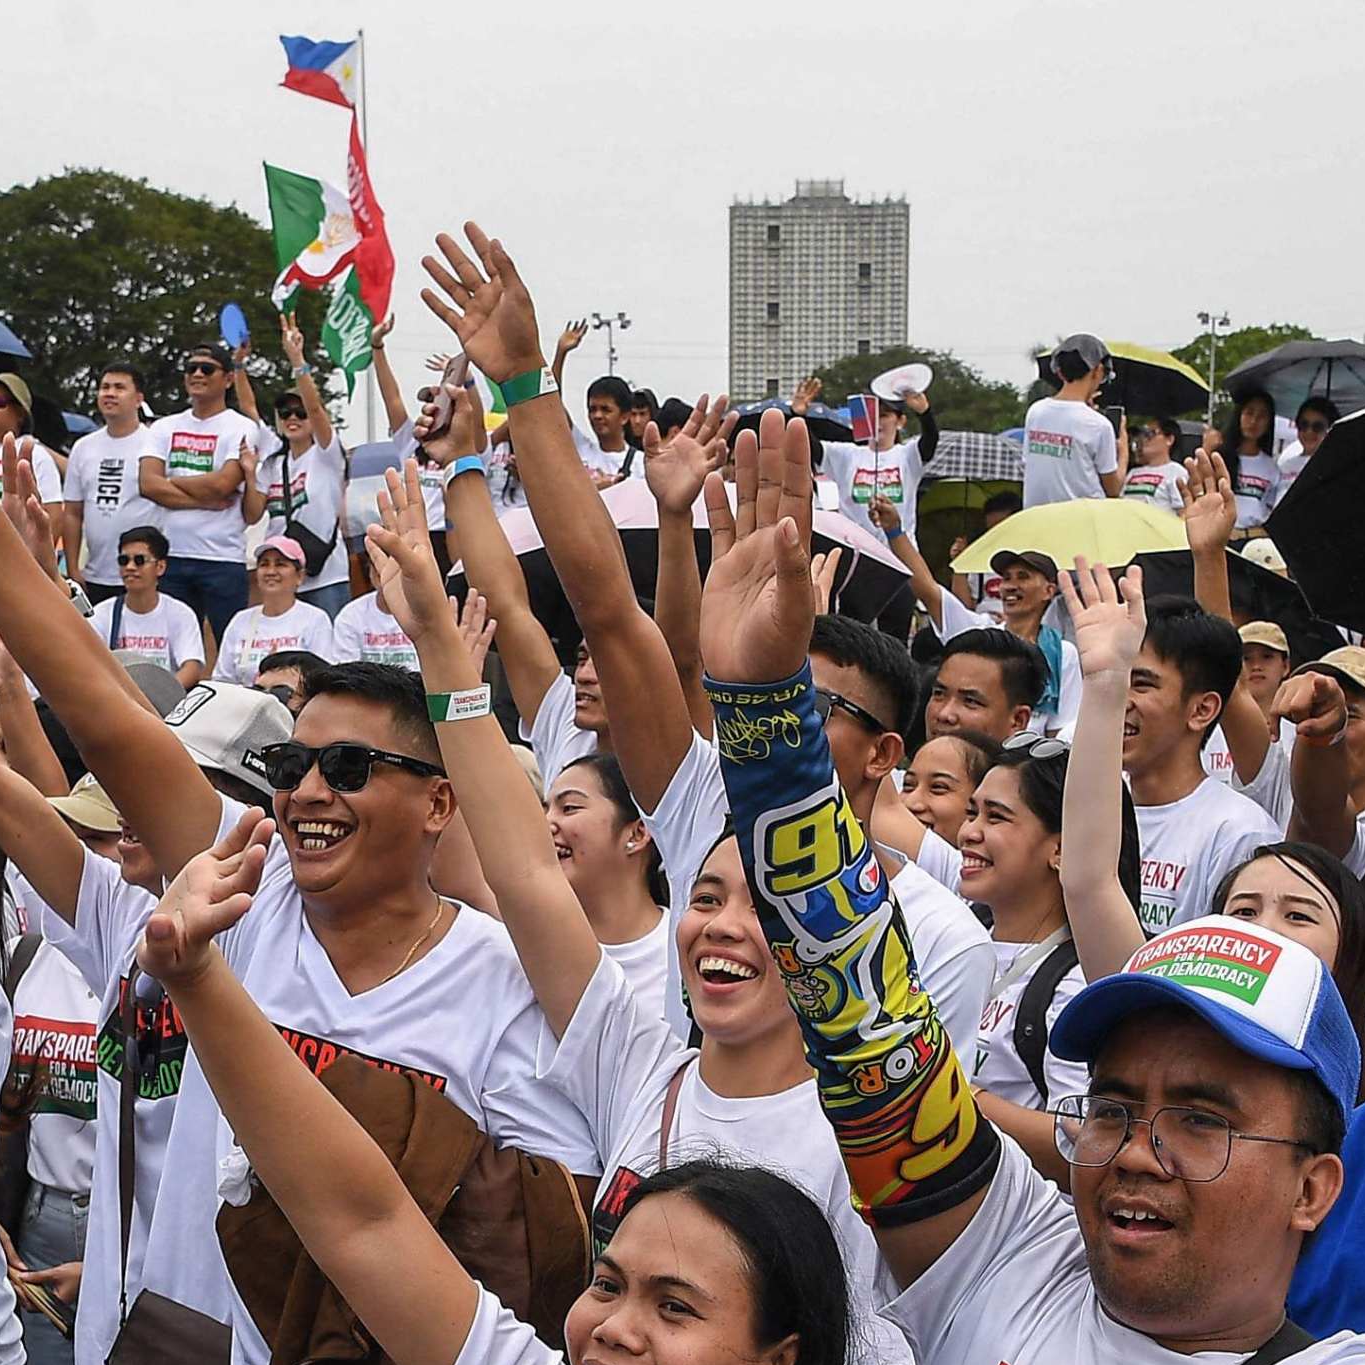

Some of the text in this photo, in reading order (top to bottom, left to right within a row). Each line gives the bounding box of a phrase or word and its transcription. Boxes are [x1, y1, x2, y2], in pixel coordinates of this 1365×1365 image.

[96, 466, 124, 506] NICE
[1134, 934, 1272, 969] TRANSPARENCY
[1173, 951, 1206, 963] FOR A
[1167, 961, 1260, 991] DEMOCRACY
[48, 1060, 77, 1077] FOR A
